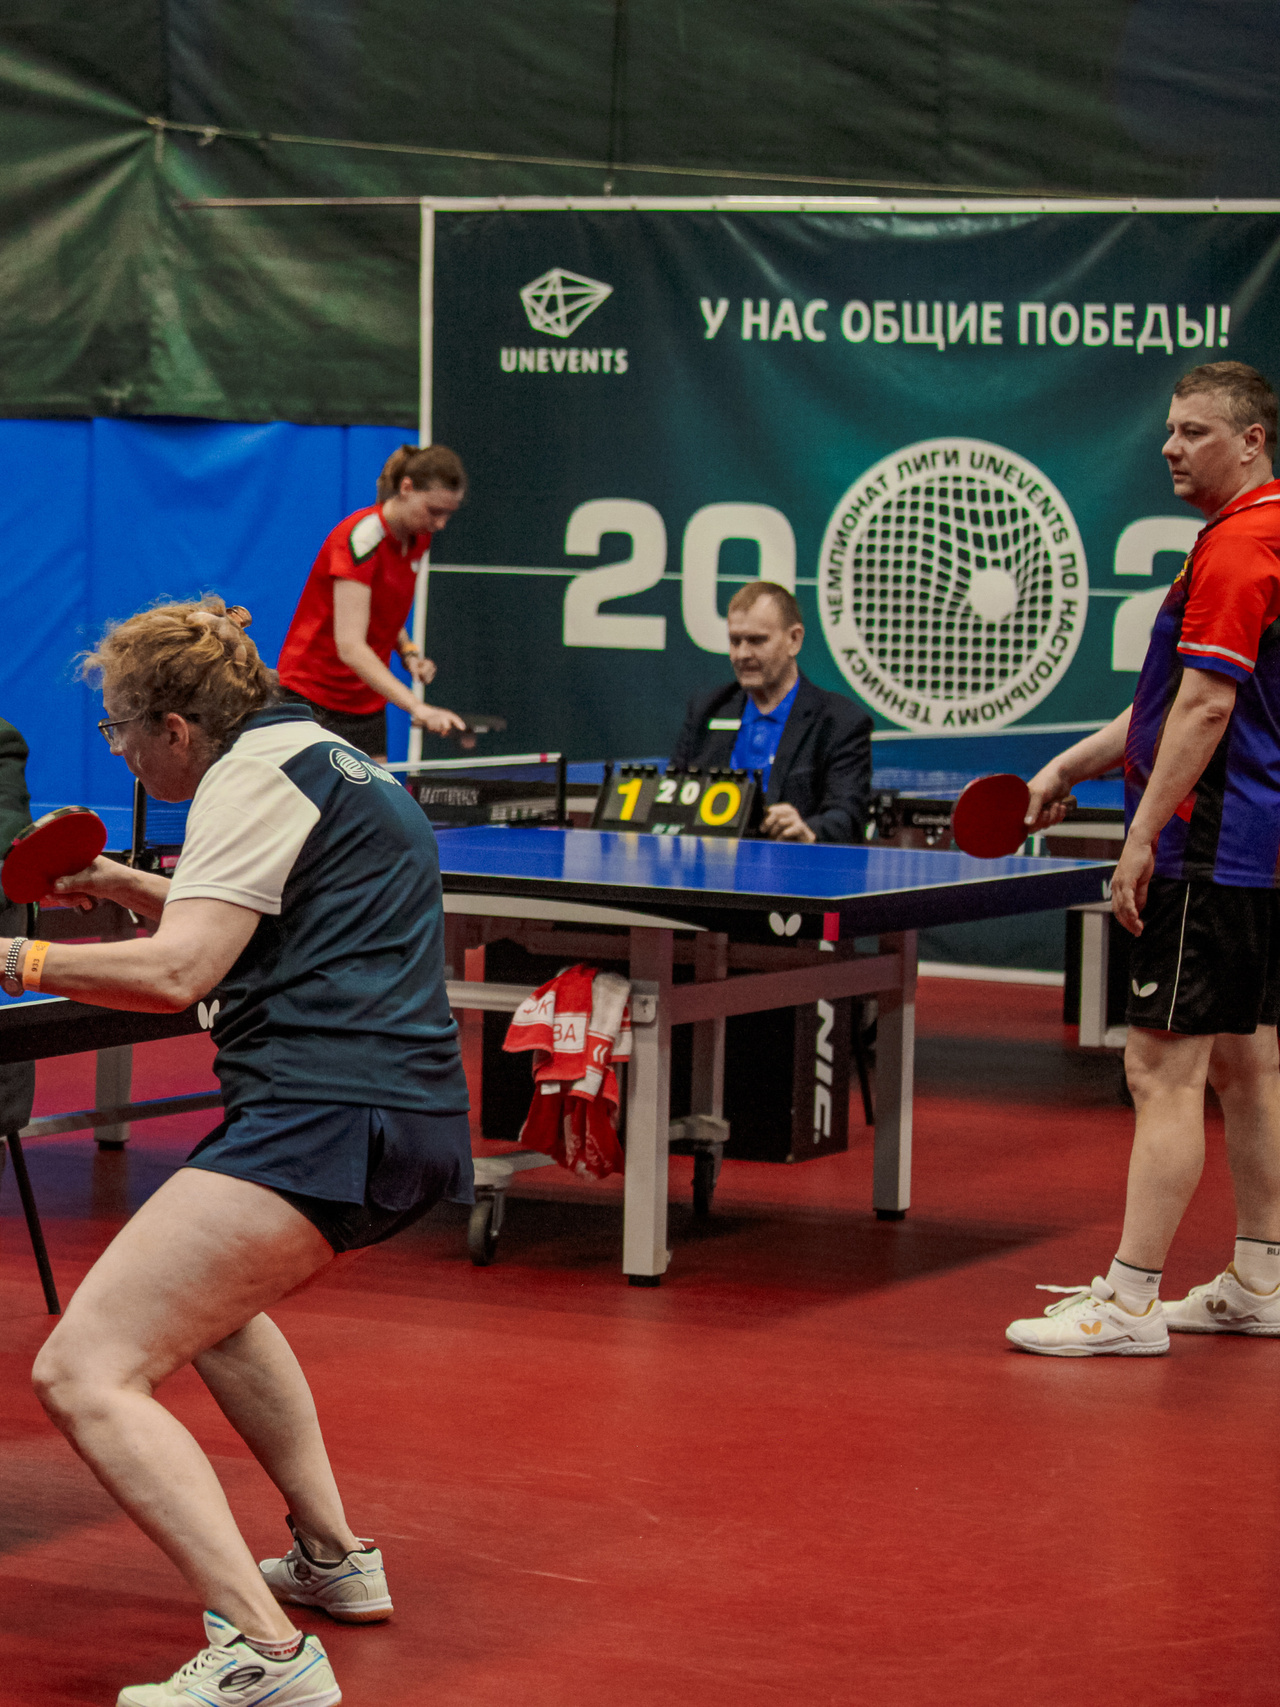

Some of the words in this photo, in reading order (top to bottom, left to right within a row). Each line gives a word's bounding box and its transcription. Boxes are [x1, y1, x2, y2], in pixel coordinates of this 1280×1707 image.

[699, 297, 730, 340] У
[741, 298, 829, 342] НАС
[841, 301, 1004, 351] ОБЩИЕ
[1018, 302, 1231, 355] ПОБЕДЫ!
[499, 347, 629, 374] UNEVENTS
[896, 449, 960, 482] ЛИГИ
[968, 449, 1071, 545] UNEVENTS
[563, 498, 797, 656] 20
[826, 473, 890, 627] ЧЕМПИОНАТ
[1058, 551, 1080, 588] ПО
[841, 647, 933, 725] ТЕННИСУ
[942, 598, 1079, 728] НАСТОЛЬНОМУ
[618, 777, 644, 821] 1
[656, 778, 679, 804] 2
[680, 780, 700, 805] 0
[699, 780, 742, 827] 0
